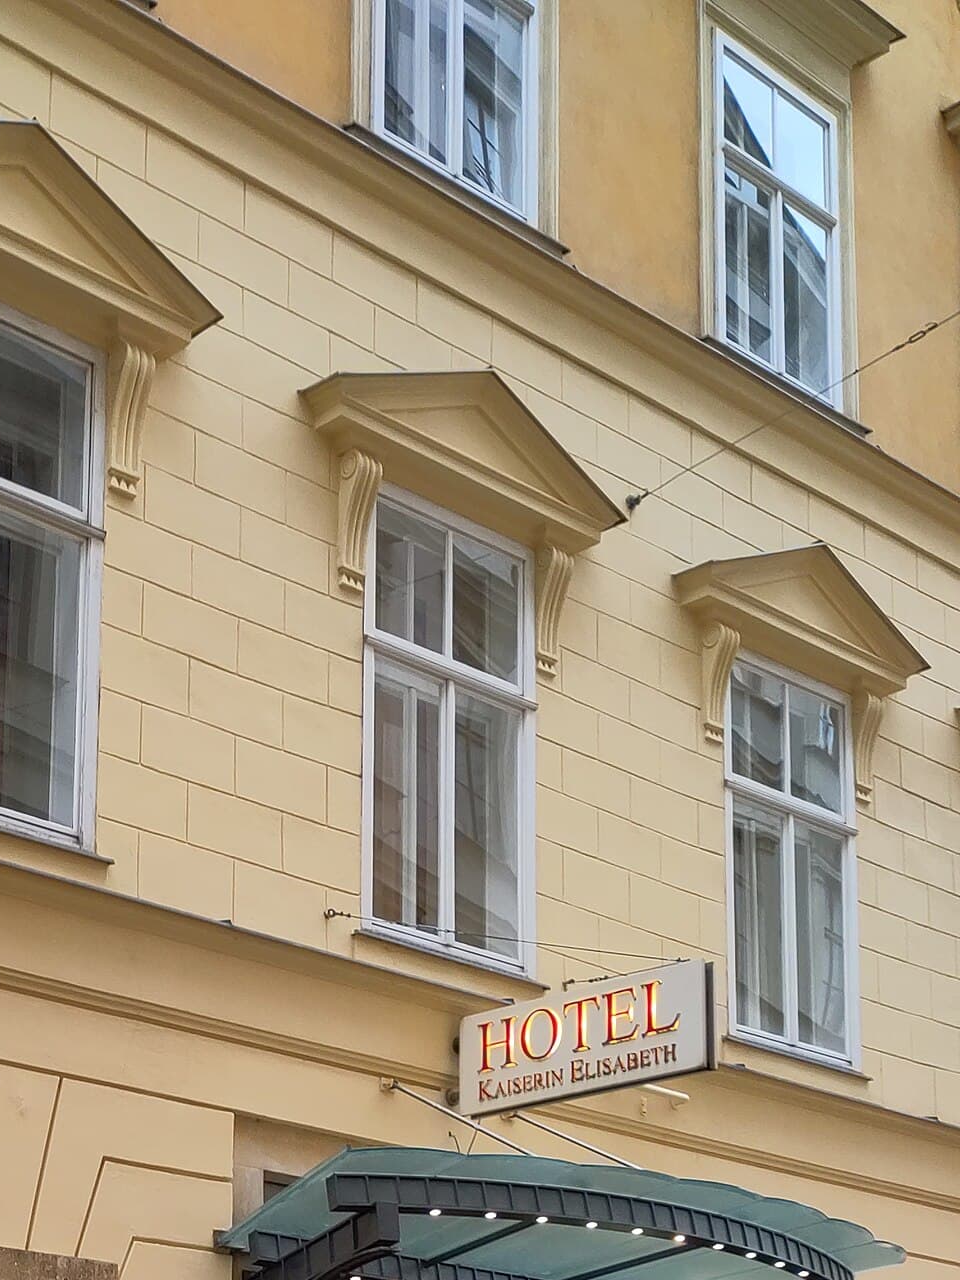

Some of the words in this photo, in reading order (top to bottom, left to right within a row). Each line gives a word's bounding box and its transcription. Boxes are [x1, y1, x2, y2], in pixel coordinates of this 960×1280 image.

[478, 980, 681, 1074] HOTEL
[478, 1069, 564, 1101] KAISERIN
[571, 1043, 677, 1082] ELISABETH
